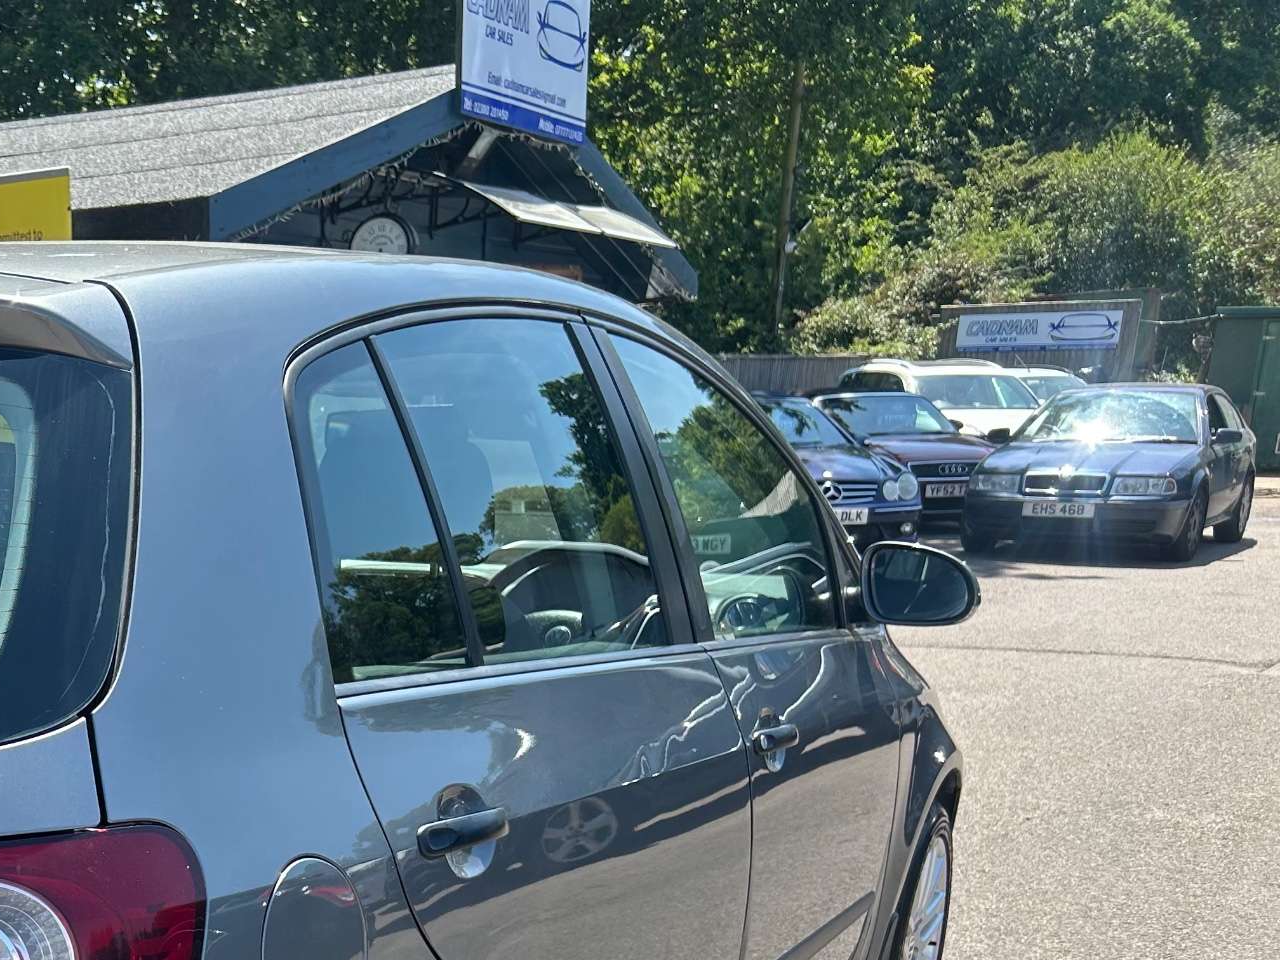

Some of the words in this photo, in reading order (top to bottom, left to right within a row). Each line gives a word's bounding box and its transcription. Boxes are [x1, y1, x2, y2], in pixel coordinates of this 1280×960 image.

[485, 24, 496, 39] CAR
[966, 319, 1039, 337] CADNAM
[1031, 503, 1057, 515] EHS
[840, 511, 863, 521] DLK
